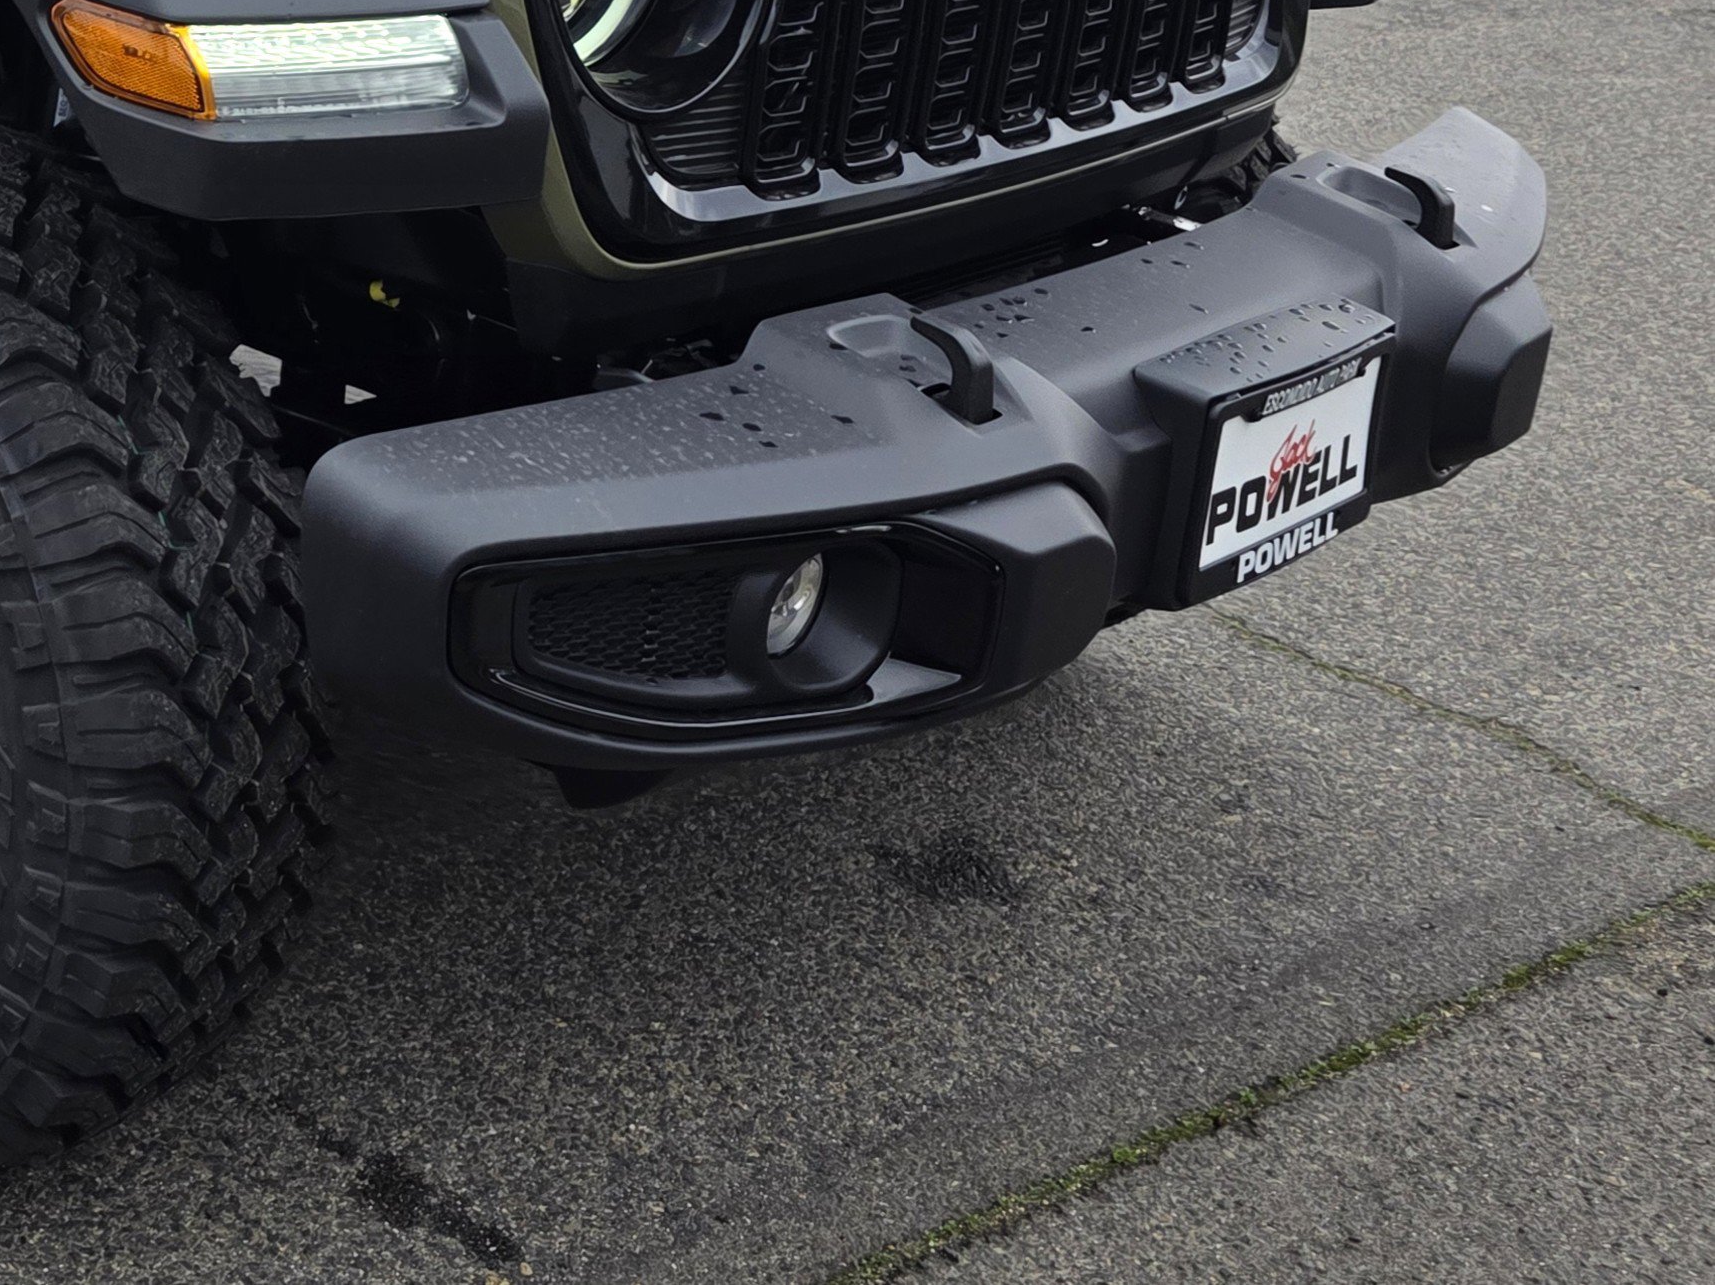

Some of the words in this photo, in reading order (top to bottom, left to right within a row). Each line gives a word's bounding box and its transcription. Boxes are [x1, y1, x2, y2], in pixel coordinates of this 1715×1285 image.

[1206, 433, 1358, 546] POWELL
[1266, 418, 1316, 503] Jack
[1237, 511, 1338, 583] POWELL
